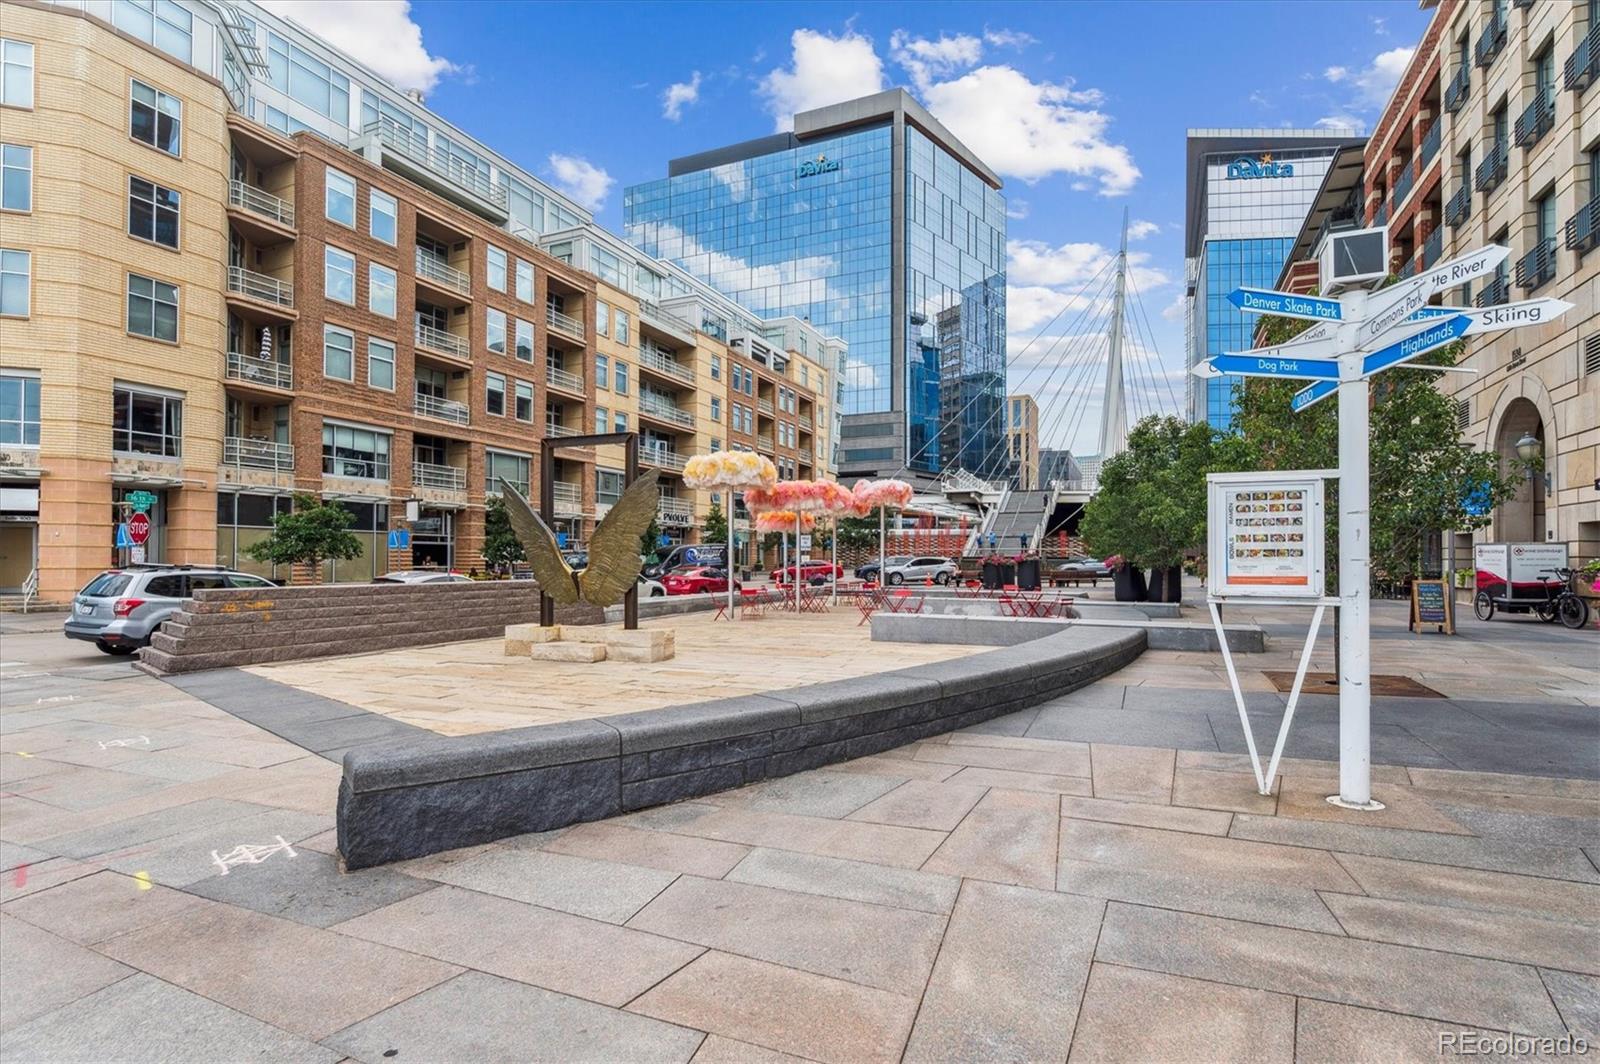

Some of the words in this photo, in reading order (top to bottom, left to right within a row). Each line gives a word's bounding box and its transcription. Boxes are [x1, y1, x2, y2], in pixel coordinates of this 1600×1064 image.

[1227, 155, 1294, 179] DaVita
[1451, 257, 1487, 281] River
[1244, 293, 1280, 310] Denver
[1284, 299, 1313, 315] Skate
[1316, 303, 1337, 318] Park
[1370, 306, 1404, 335] Commons
[1406, 290, 1422, 311] Park
[1482, 307, 1541, 326] Skiing
[1401, 322, 1453, 355] Highlands
[1258, 359, 1277, 371] Dog
[1279, 360, 1298, 371] Park
[131, 522, 148, 534] STOP
